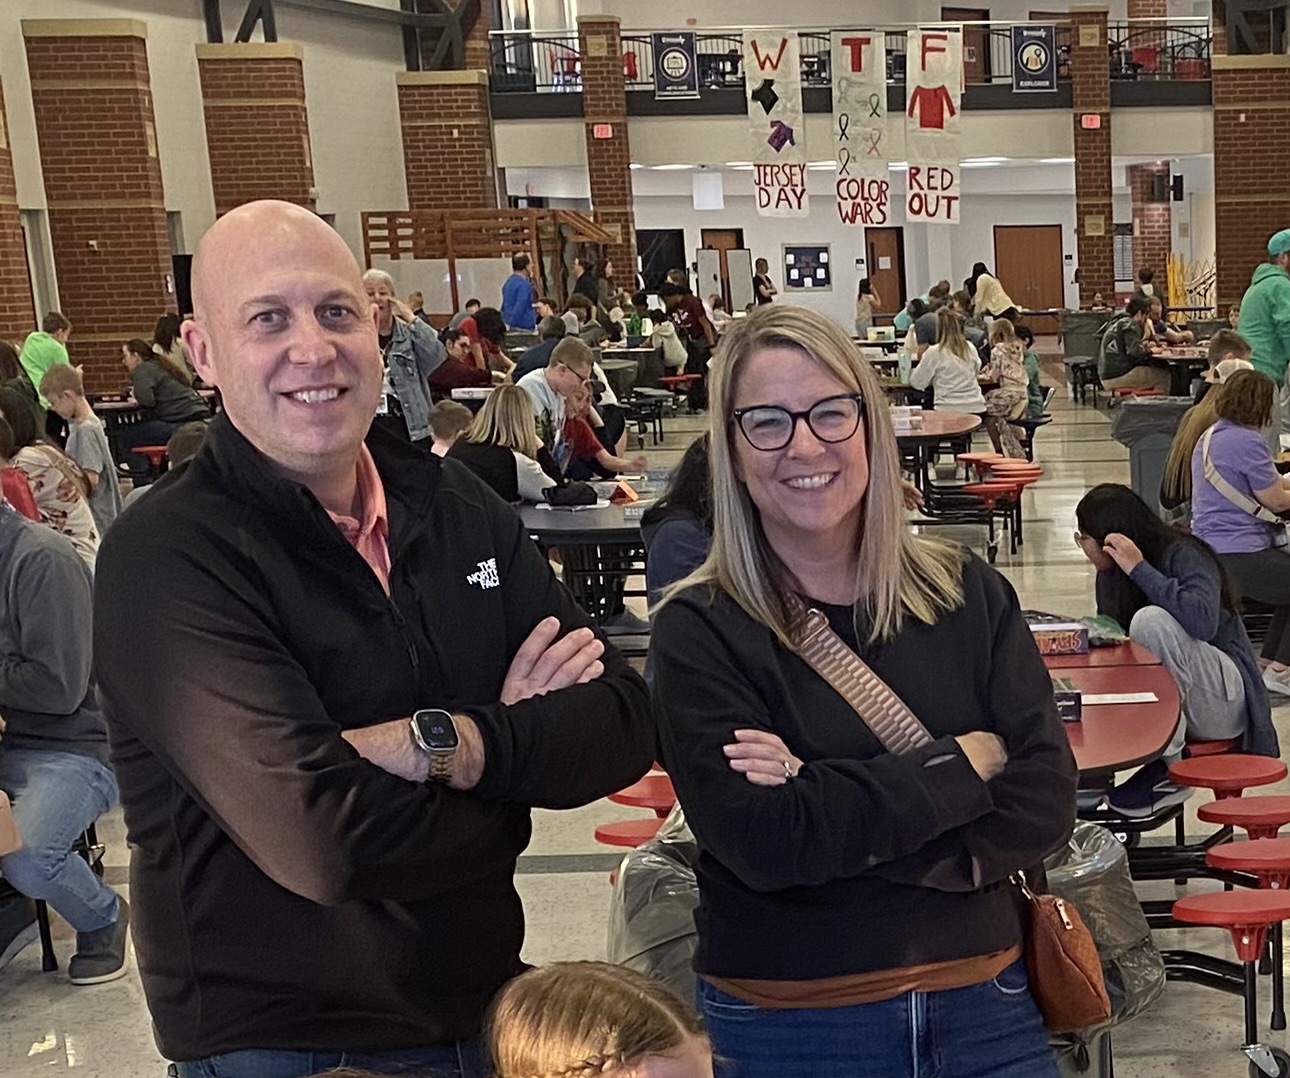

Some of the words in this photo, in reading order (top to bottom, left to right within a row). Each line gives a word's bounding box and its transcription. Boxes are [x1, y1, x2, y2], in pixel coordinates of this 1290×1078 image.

[751, 38, 788, 71] W
[841, 37, 871, 73] T
[921, 34, 948, 72] F
[754, 163, 806, 188] JERSEY
[908, 166, 954, 191] RED
[759, 188, 806, 210] DAY
[836, 178, 889, 202] COLOR
[838, 201, 887, 225] WARS
[908, 193, 959, 220] OUT
